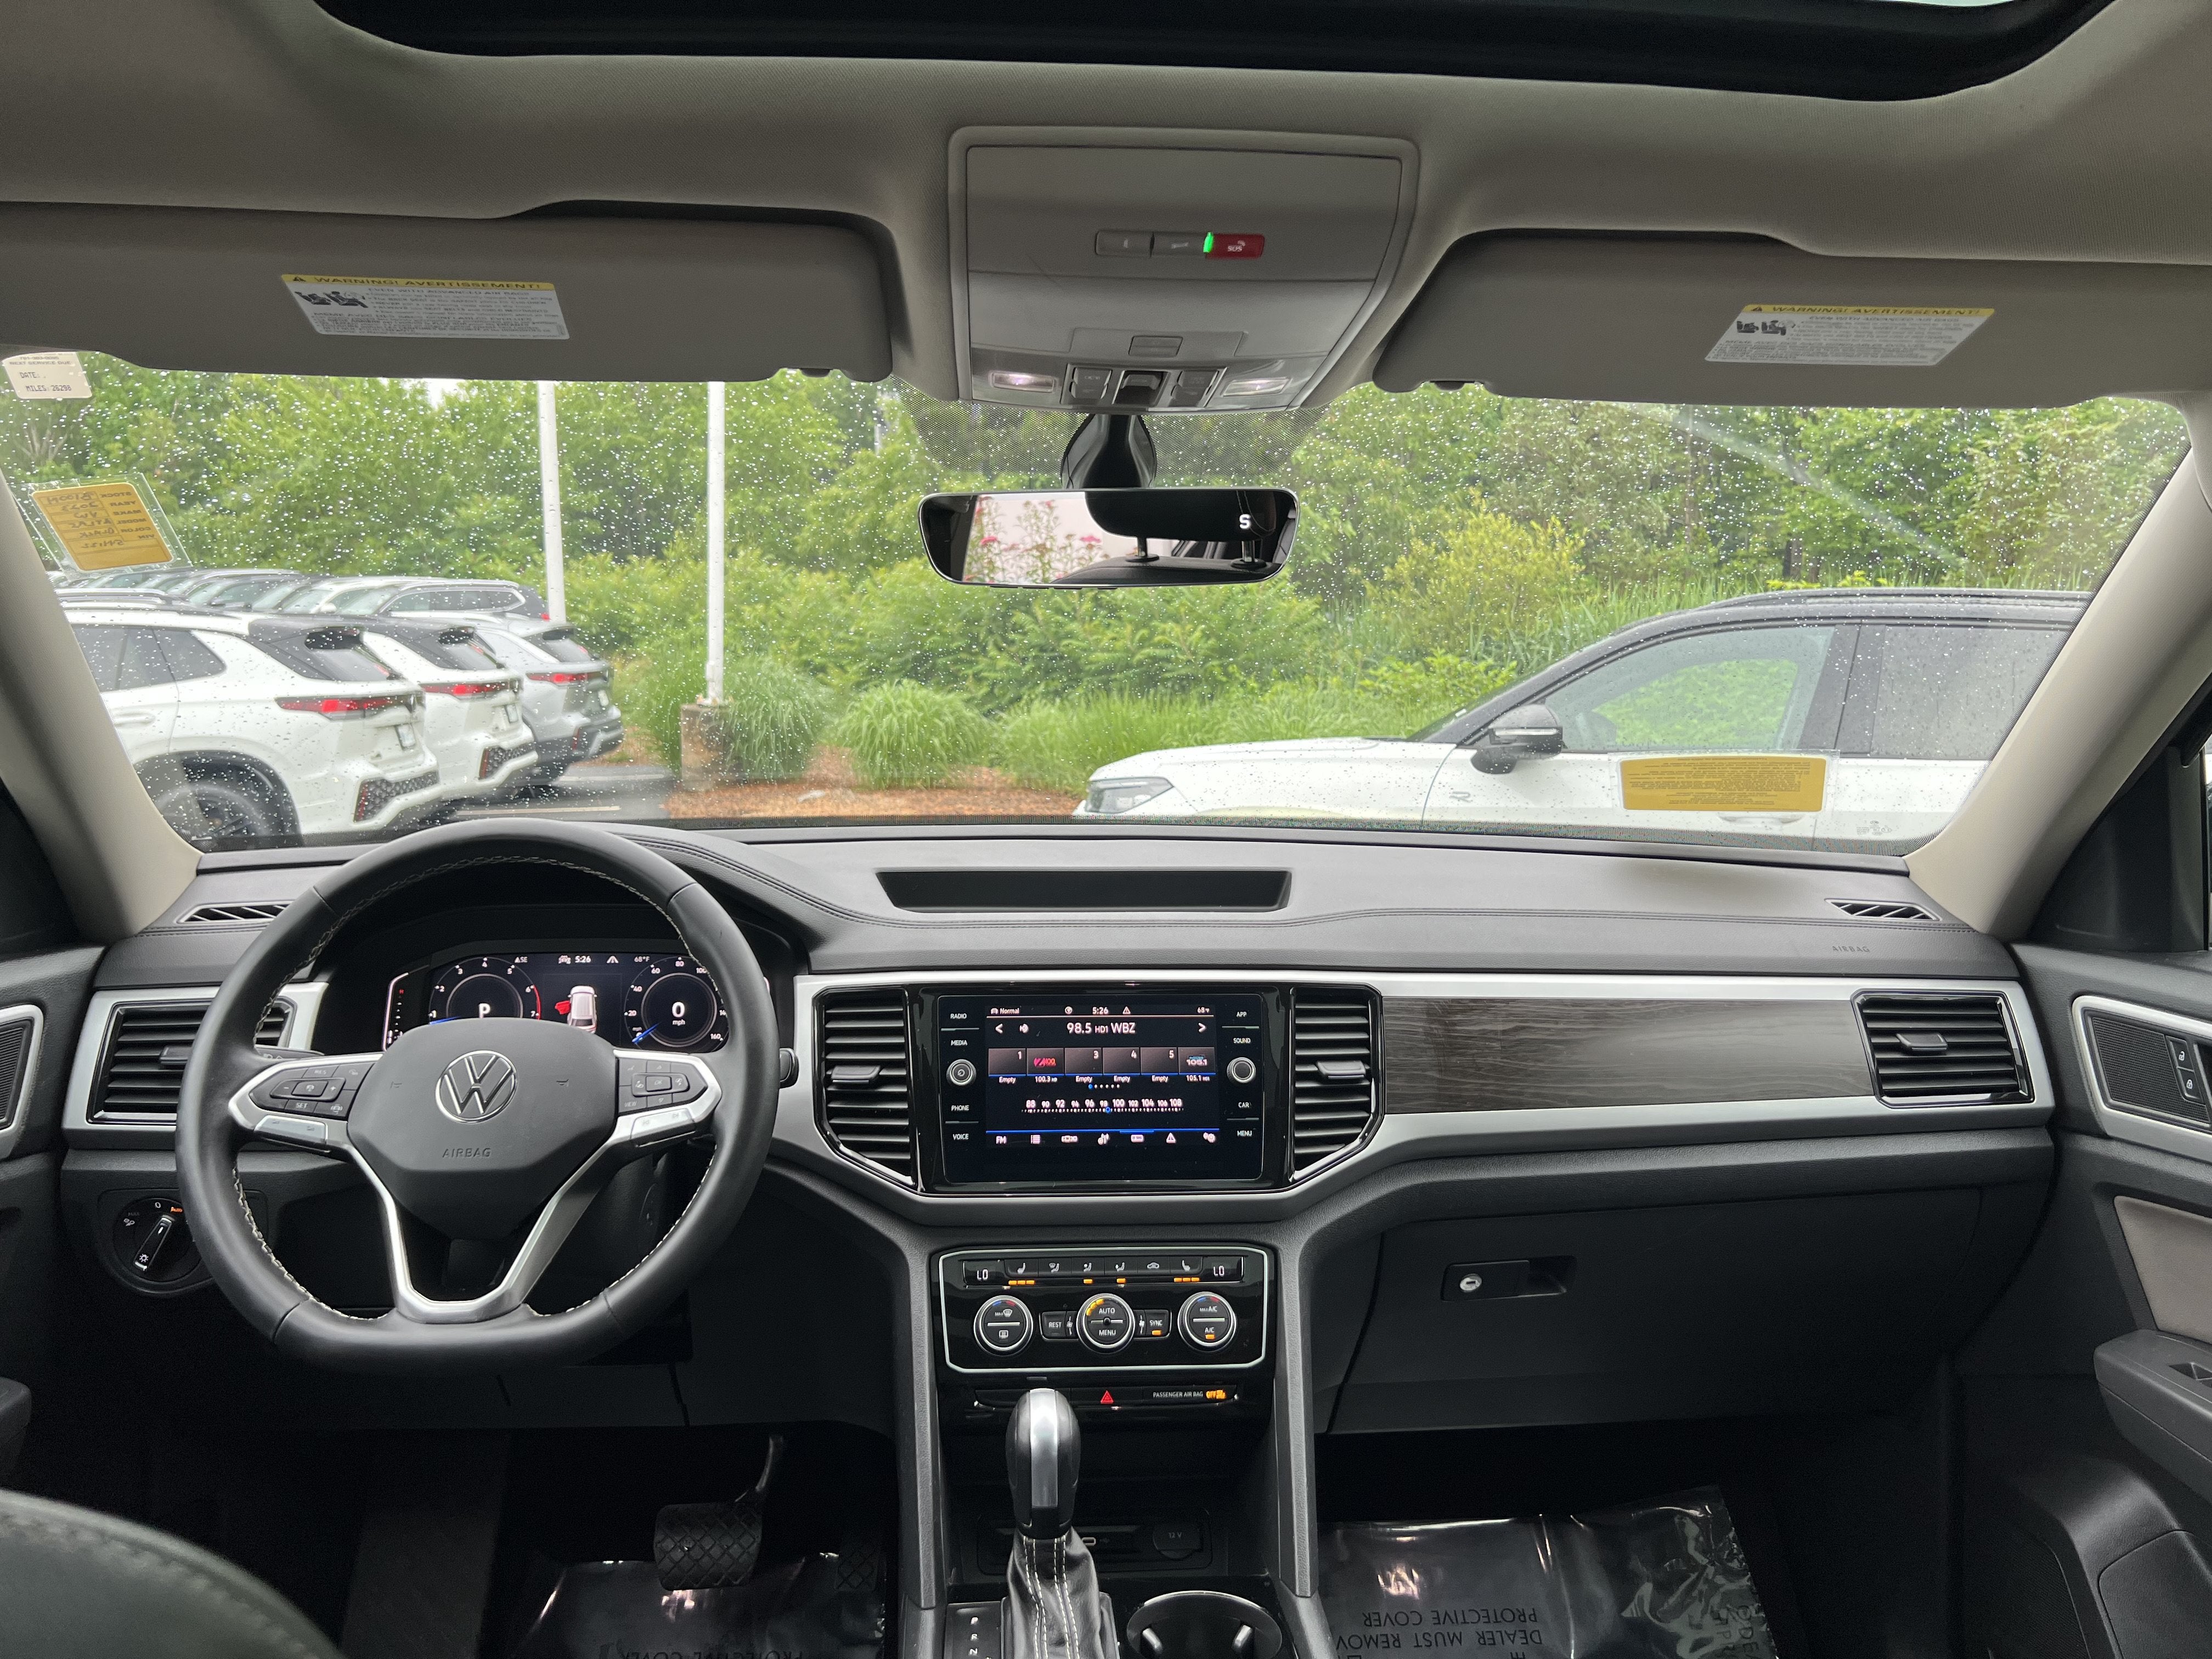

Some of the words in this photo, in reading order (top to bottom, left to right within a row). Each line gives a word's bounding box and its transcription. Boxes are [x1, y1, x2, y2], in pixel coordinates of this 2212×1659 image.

[314, 276, 398, 285] WARNING!
[405, 280, 540, 289] AVERTISSEMENT!
[1239, 514, 1251, 529] S
[575, 955, 591, 963] 5:26
[478, 1003, 491, 1018] P
[672, 1001, 685, 1018] 0
[1066, 1022, 1092, 1034] 98.5
[1094, 1025, 1108, 1034] HD1
[1111, 1022, 1136, 1034] WBZ
[1018, 1051, 1022, 1060] 1
[1093, 1050, 1099, 1059] 3
[1131, 1049, 1137, 1059] 4
[1169, 1049, 1175, 1059] 5
[998, 1076, 1017, 1084] Empty
[1075, 1075, 1093, 1084] Empty
[1113, 1075, 1131, 1083] Empty
[1152, 1075, 1169, 1083] Empty
[1056, 1099, 1065, 1108] 92
[1085, 1099, 1094, 1108] 96
[1112, 1099, 1125, 1107] 100
[1141, 1098, 1154, 1107] 104
[1170, 1098, 1182, 1107] 108
[996, 1136, 1007, 1144] FM
[442, 1147, 491, 1159] AIRBAG
[1362, 1610, 1423, 1628] COVER
[1431, 1607, 1538, 1626] PROTECTIVE
[970, 1633, 979, 1641] R
[1335, 1633, 1401, 1650] REMOV
[1413, 1631, 1463, 1648] MUST
[1475, 1629, 1543, 1646] DEALER
